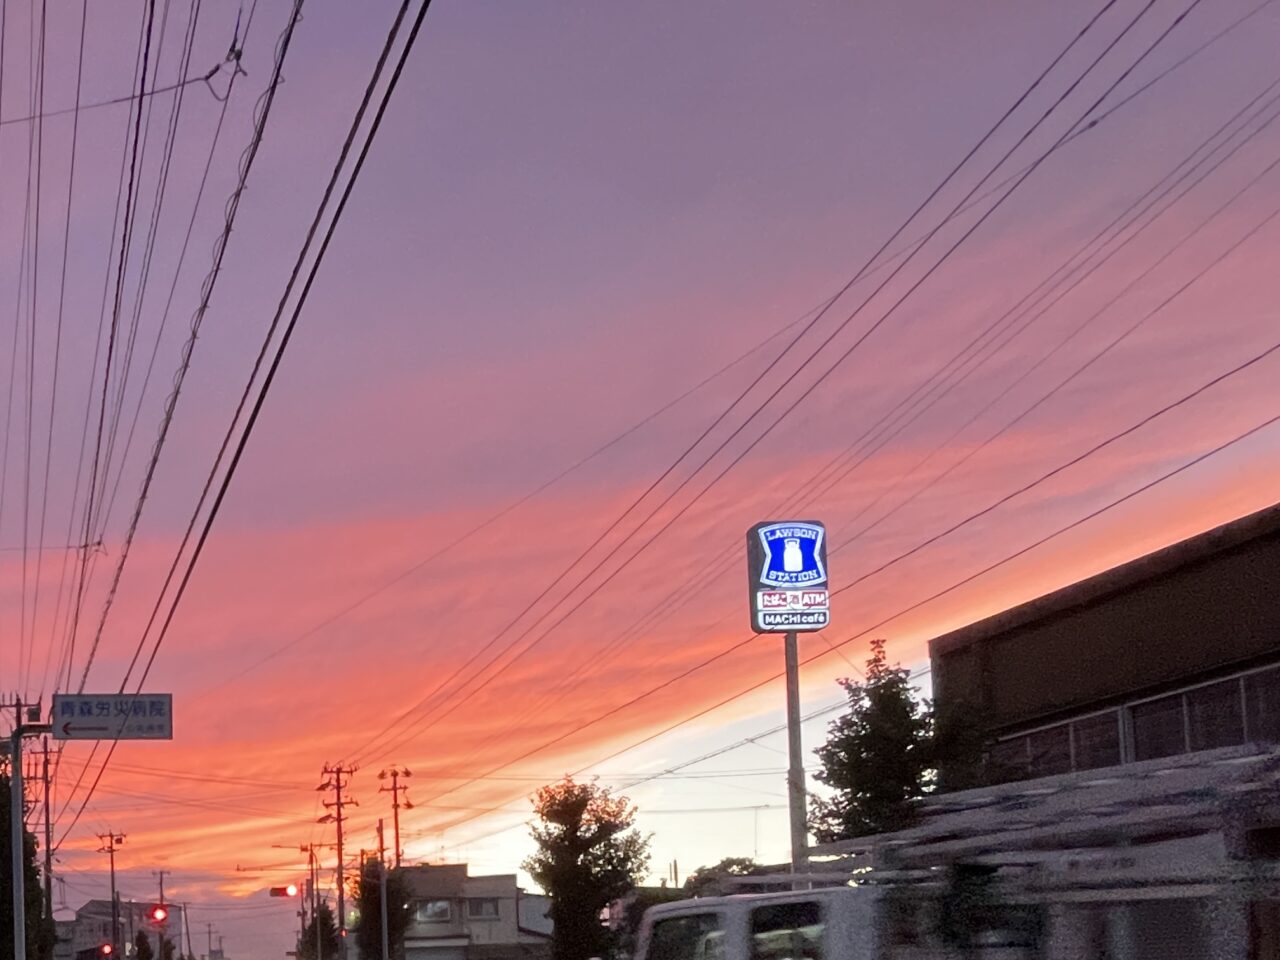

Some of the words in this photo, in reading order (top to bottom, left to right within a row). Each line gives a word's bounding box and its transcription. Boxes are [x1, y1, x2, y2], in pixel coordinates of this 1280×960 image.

[765, 528, 817, 541] LAWSON
[768, 569, 818, 582] STATION
[803, 593, 825, 605] ATM
[765, 614, 800, 624] MACHI
[801, 613, 825, 623] café
